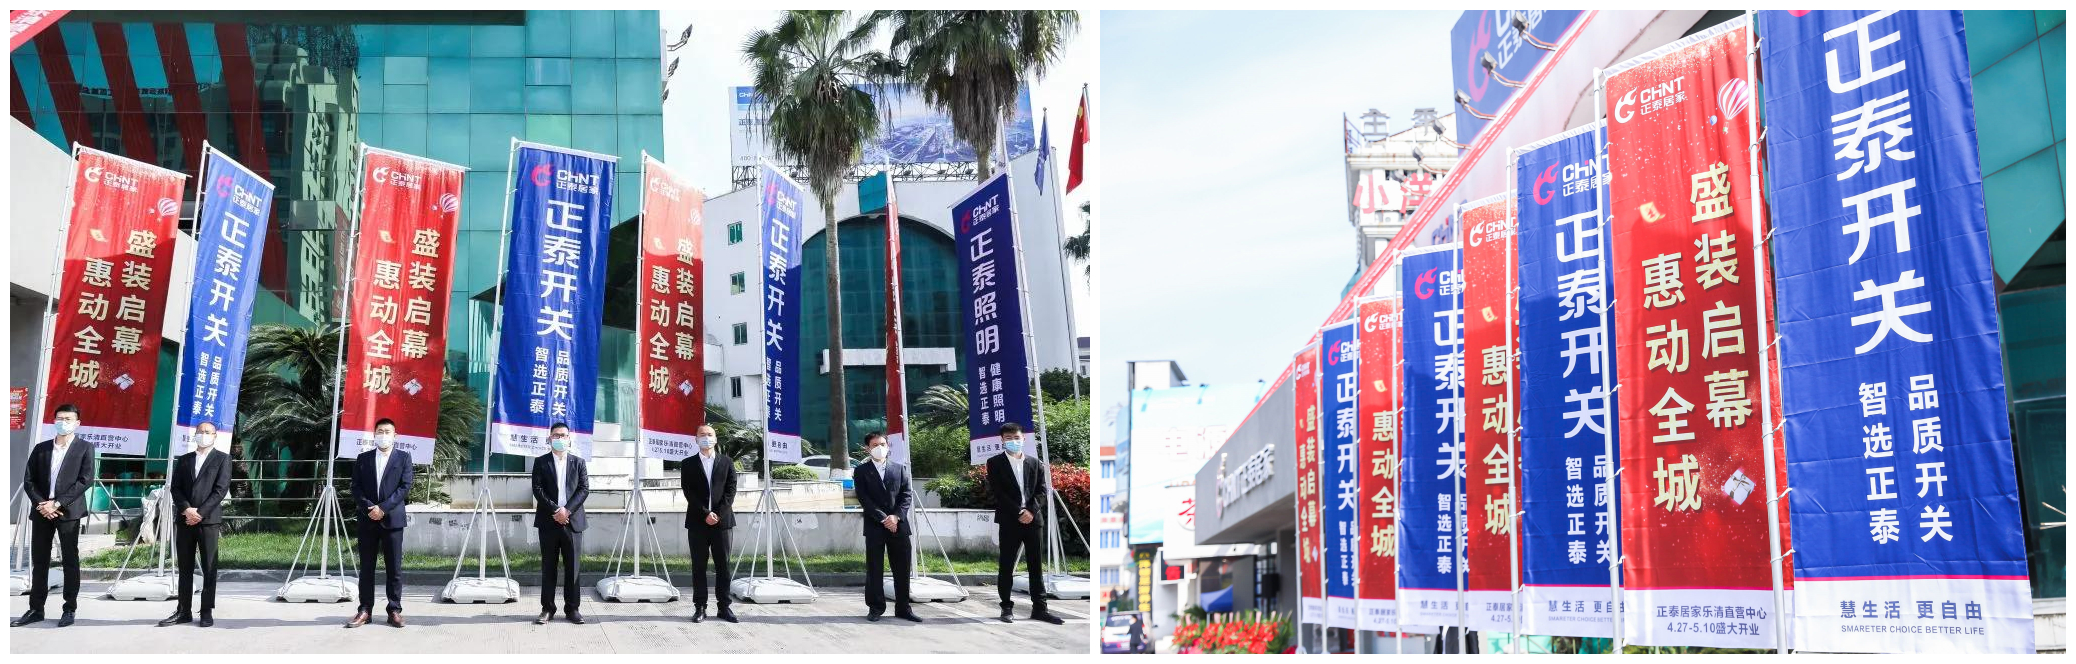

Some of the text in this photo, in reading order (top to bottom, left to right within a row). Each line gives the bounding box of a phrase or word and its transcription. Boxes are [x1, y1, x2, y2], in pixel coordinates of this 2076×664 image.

[1640, 91, 1687, 115] 正泰居家
[556, 180, 599, 195] 正泰居家
[1823, 10, 1933, 355] 正泰开关
[67, 258, 115, 389] 惠动全城
[110, 229, 158, 356] 盛装启幕
[203, 211, 250, 347] 正泰开关
[363, 259, 402, 395] 惠动全城
[401, 228, 441, 360] 盛装启幕
[537, 199, 585, 341] 正泰开关
[648, 265, 671, 396] 惠动全城
[675, 238, 694, 361] 盛装启幕
[767, 218, 790, 351] 正泰开关
[970, 227, 1000, 355] 正泰照明
[1555, 209, 1606, 438] 正泰开关
[1690, 161, 1752, 428] 盛装启幕
[192, 351, 210, 415] 智选正泰
[204, 355, 222, 418] 品质开关
[530, 346, 549, 415] 智选正泰
[552, 350, 570, 417] 品质开关
[979, 366, 990, 426] 智选正泰
[990, 362, 1005, 423] 健康照明
[1481, 345, 1510, 536] 惠动全城
[1641, 252, 1702, 513] 惠动全城
[1370, 410, 1395, 558] 惠动全城
[1565, 456, 1587, 565] 智选正泰
[1858, 381, 1900, 545] 智选正泰
[1908, 373, 1953, 543] 品质开关
[1437, 493, 1452, 574] 智选正泰
[1656, 605, 1767, 620] 正泰居家乐清直营中心
[1667, 622, 1760, 636] 4.27-5.10盛大开业
[1840, 600, 1983, 620] 慧生活 更自由
[1841, 625, 1985, 636] SMARETER CHOICE BETTER LIFE
